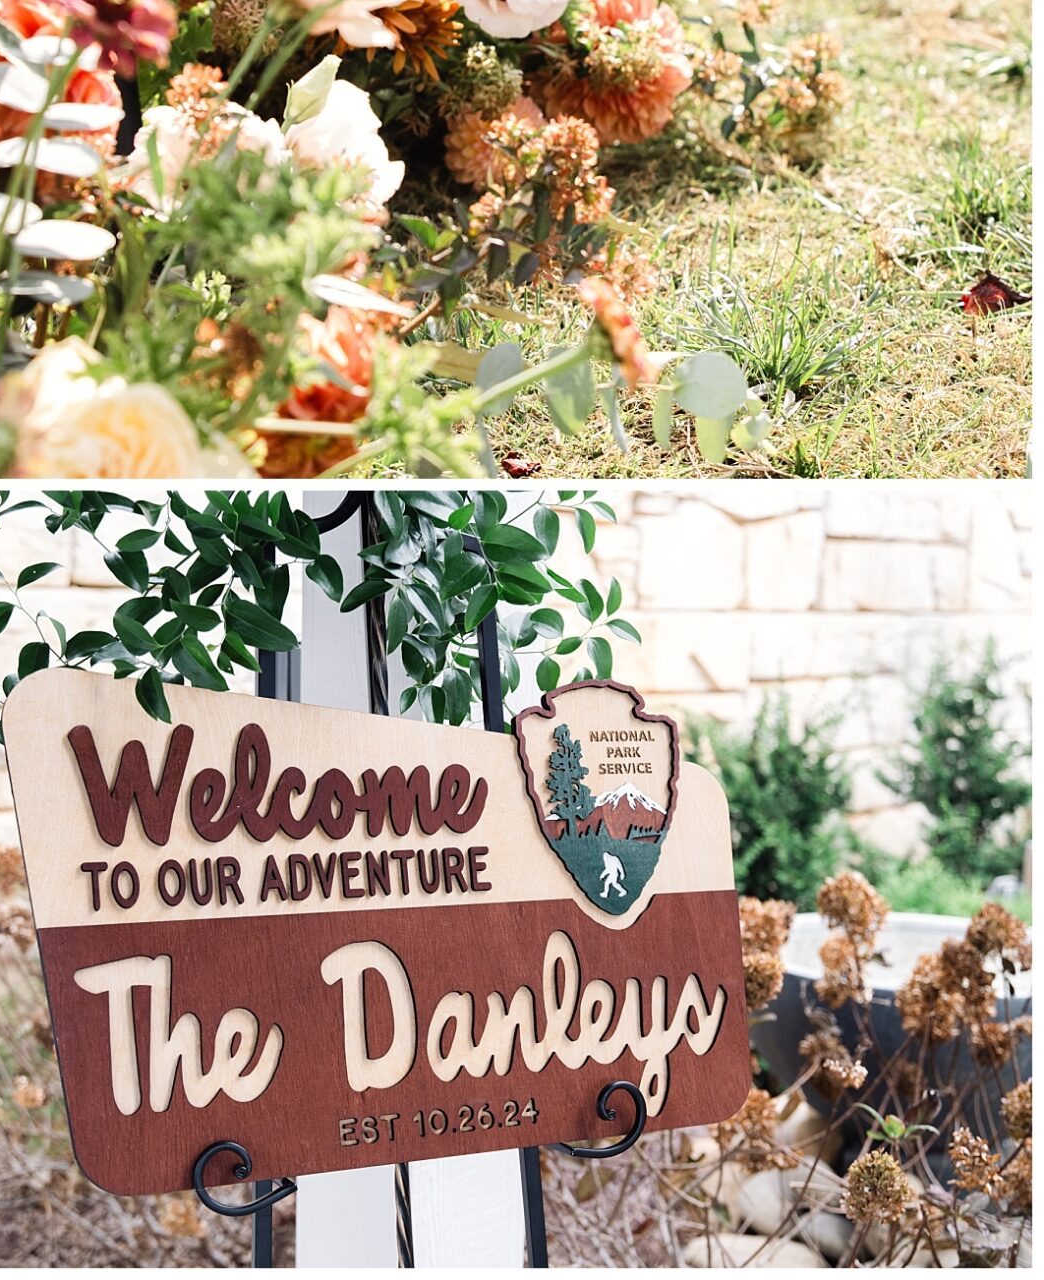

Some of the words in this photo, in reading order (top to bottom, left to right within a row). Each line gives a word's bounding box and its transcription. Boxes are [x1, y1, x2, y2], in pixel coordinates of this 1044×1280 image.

[588, 729, 655, 745] NATIONAL
[606, 746, 641, 759] PARK
[67, 722, 489, 847] Welcome
[598, 762, 653, 775] SERVICE
[80, 860, 140, 911] TO
[156, 854, 245, 907] OUR
[260, 844, 493, 903] ADVENTURE
[73, 953, 284, 1117] The
[320, 929, 728, 1118] Danleys
[339, 1114, 401, 1148] EST
[413, 1097, 541, 1137] 10.26.24
